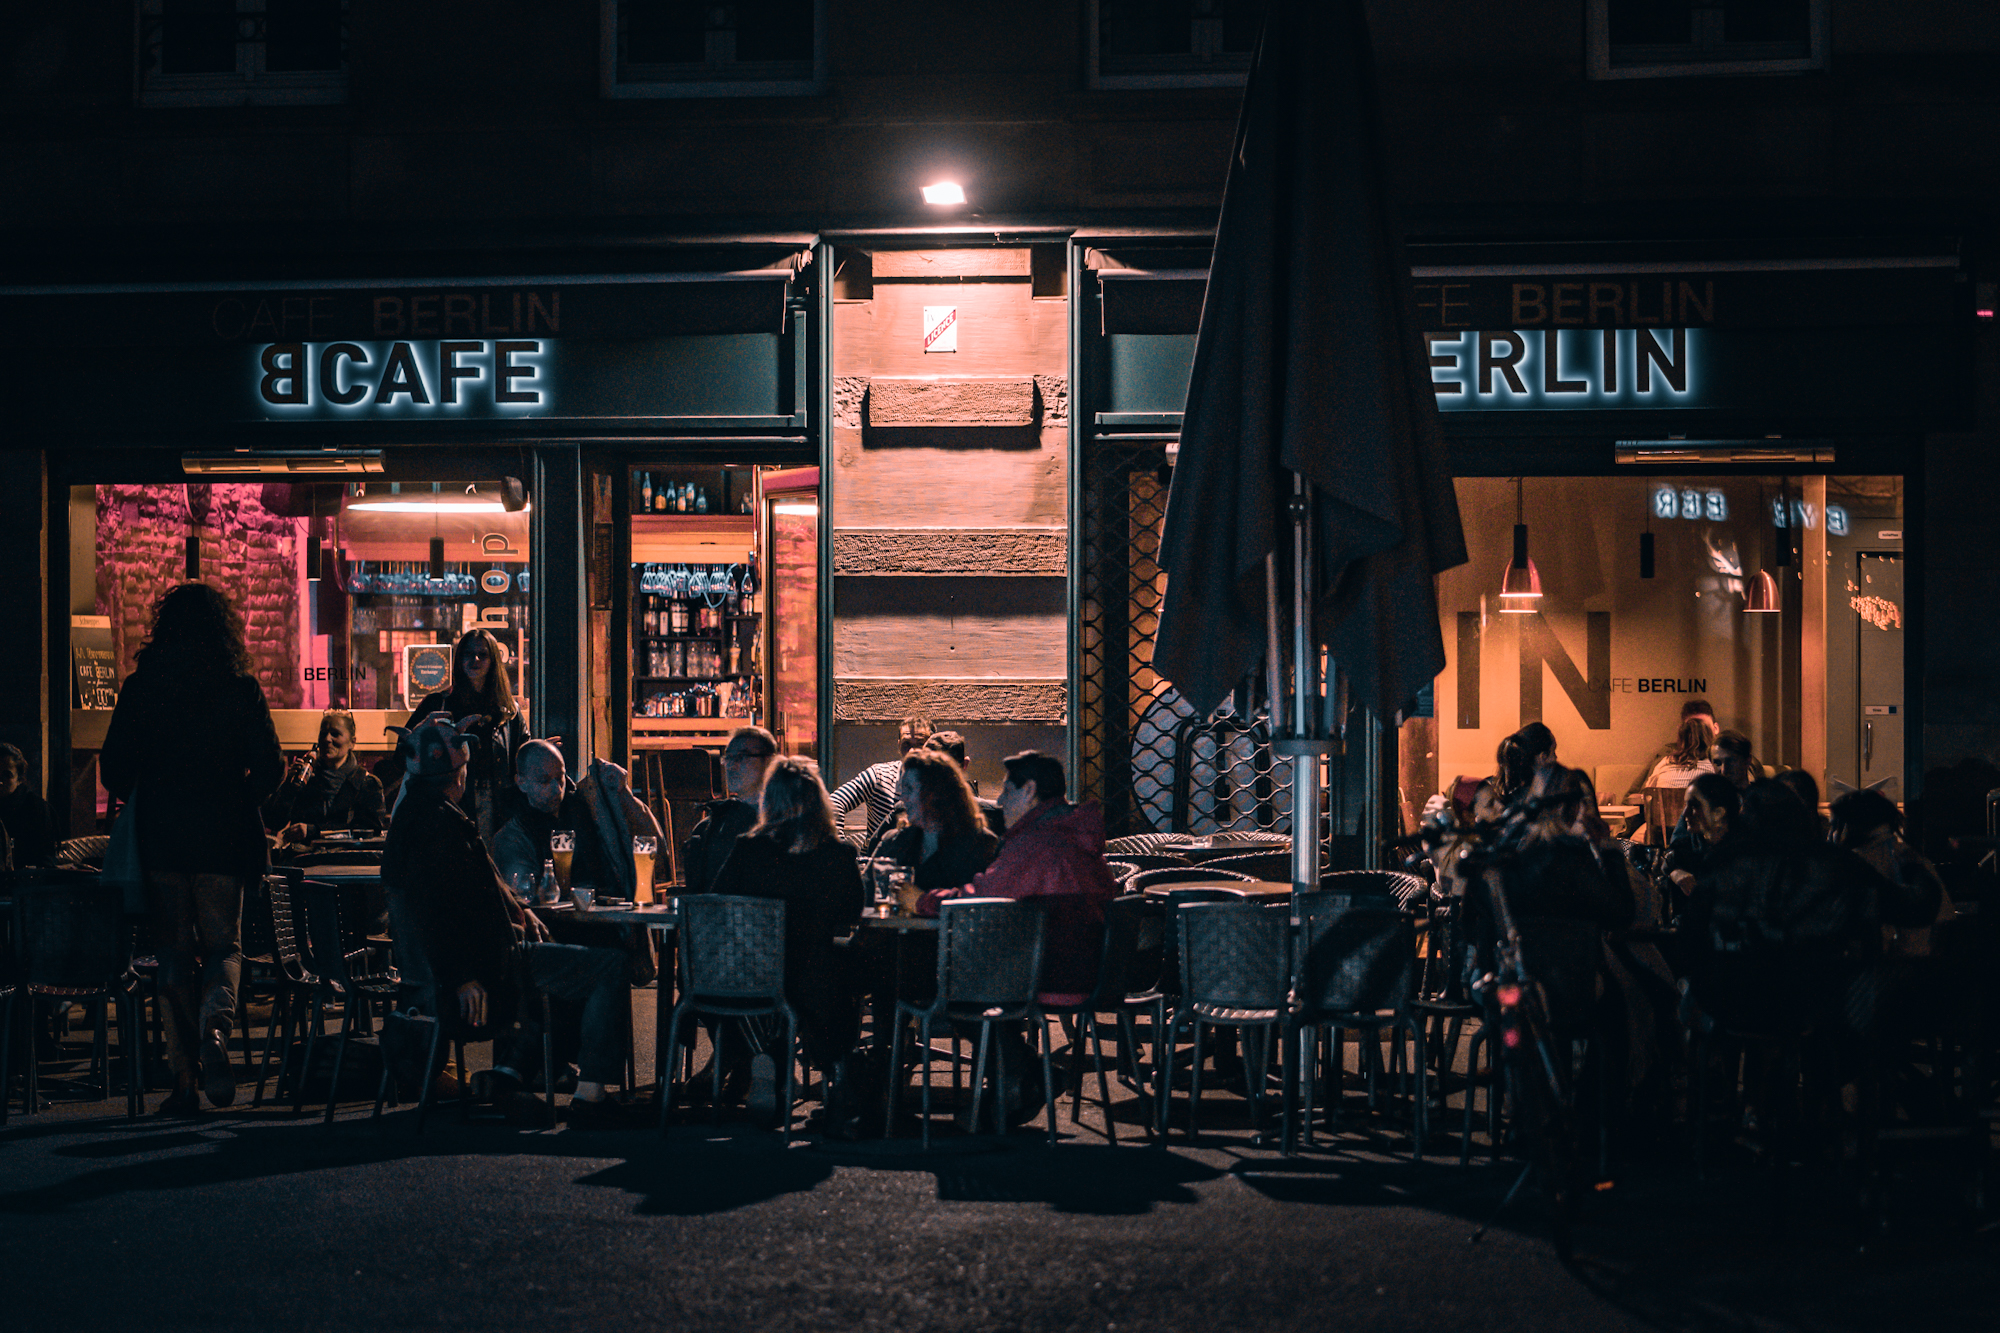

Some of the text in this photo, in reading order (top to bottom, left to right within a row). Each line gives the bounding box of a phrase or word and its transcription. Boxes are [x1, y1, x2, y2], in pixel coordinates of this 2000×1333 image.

[212, 292, 561, 340] CAFE BERLIN
[1511, 280, 1715, 326] BERLIN
[1422, 327, 1687, 395] ERLIN
[304, 667, 366, 681] BERLIN
[1456, 611, 1611, 730] IN
[1587, 677, 1707, 694] CAFE BERLIN
